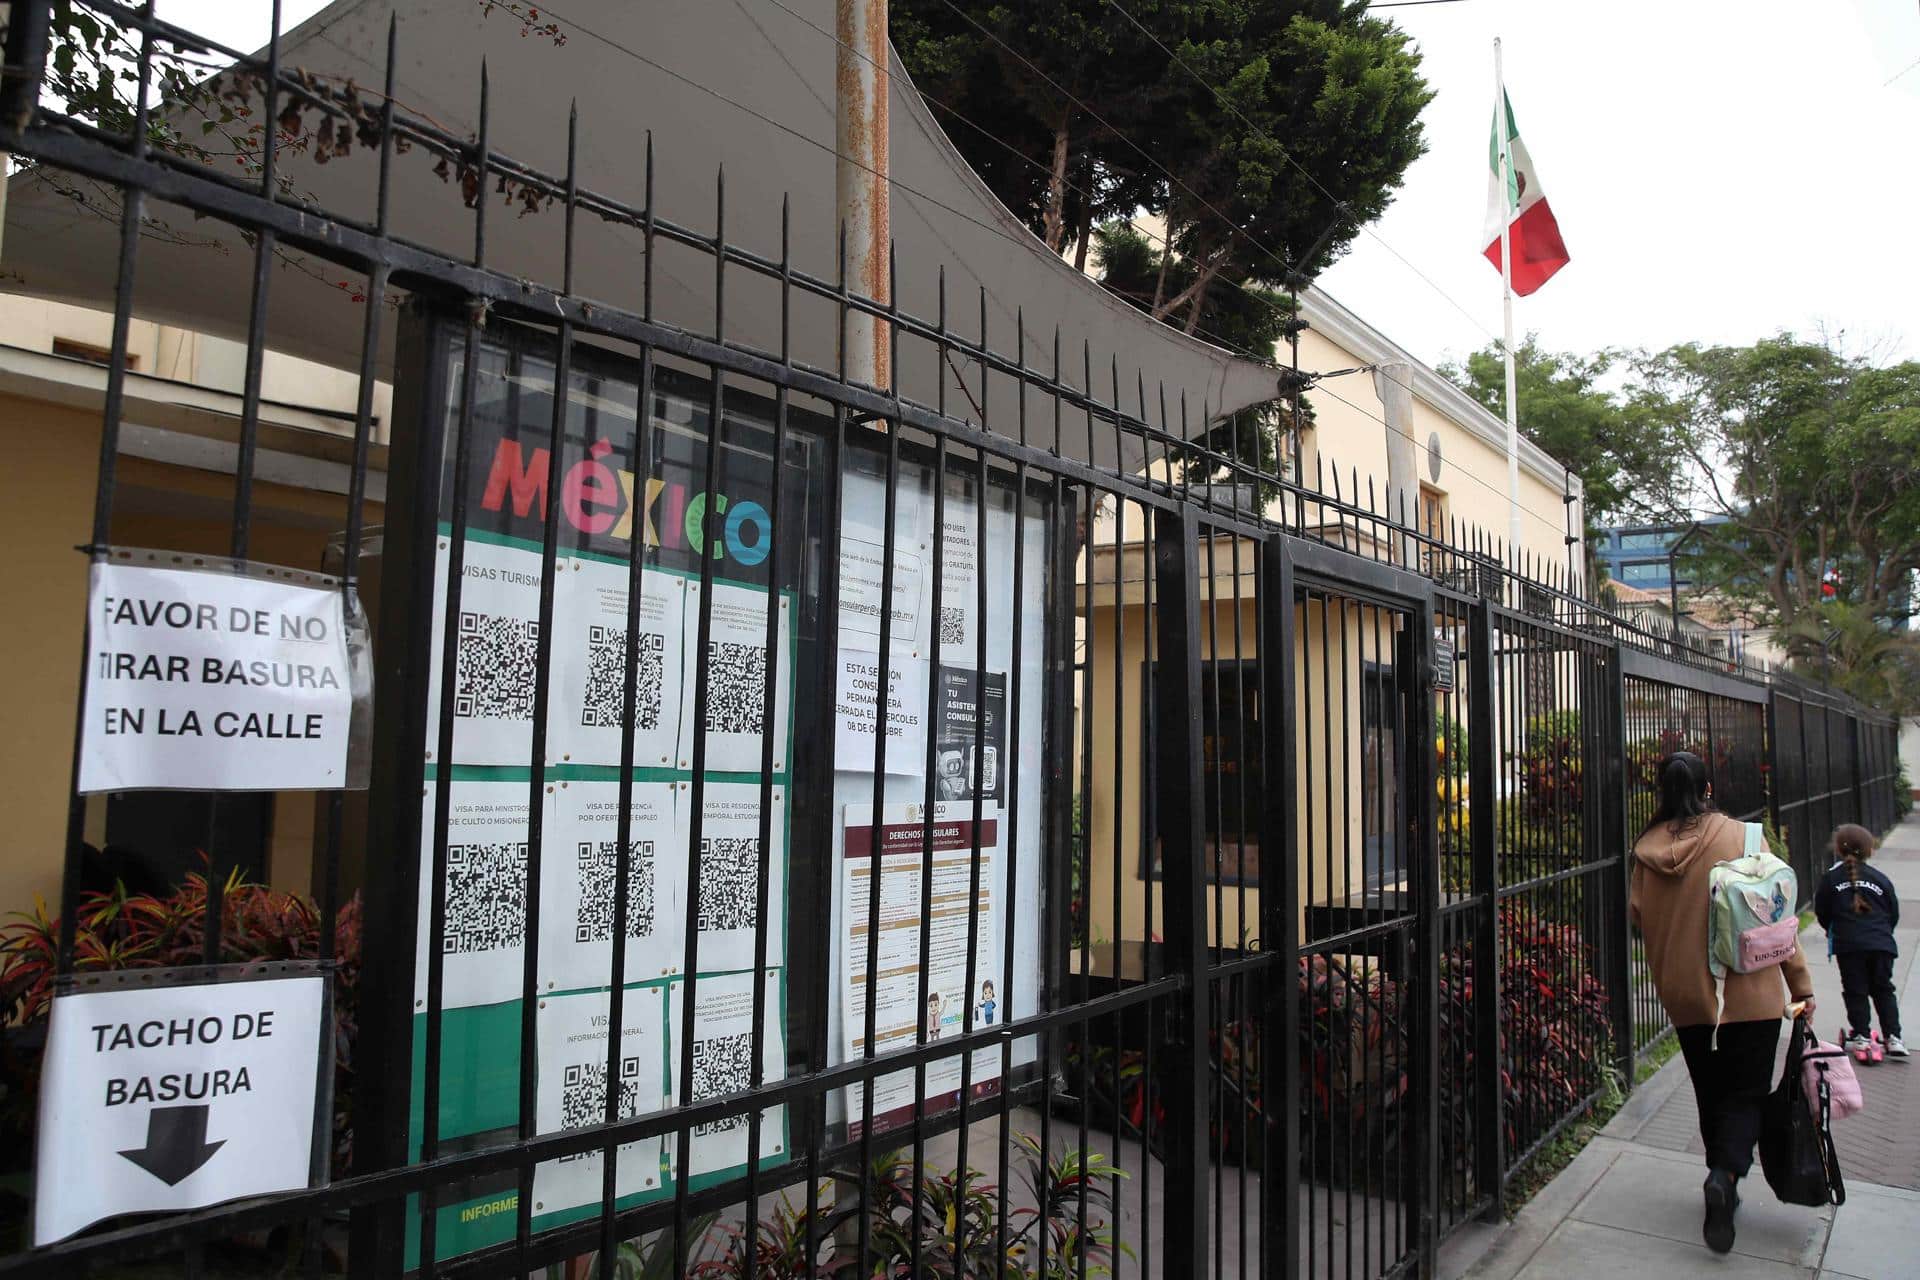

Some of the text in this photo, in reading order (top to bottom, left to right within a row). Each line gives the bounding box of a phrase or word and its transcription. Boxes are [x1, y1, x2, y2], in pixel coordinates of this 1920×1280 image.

[500, 570, 541, 588] TURISM
[105, 598, 327, 641] FAVOR DE NO
[100, 651, 339, 690] TIRAR BASURA
[846, 663, 866, 675] ESTA
[846, 692, 902, 708] PERMANERÁ
[947, 689, 958, 698] TU
[947, 700, 977, 711] ASISTEN
[866, 709, 876, 719] EL
[946, 712, 977, 722] CONSUL
[105, 708, 323, 739] EN LA CALLE
[857, 722, 868, 733] DE
[889, 830, 921, 840] DERECHOS
[91, 1011, 274, 1052] TACHO DE
[105, 1067, 252, 1107] BASURA
[462, 1196, 519, 1223] INFORME
